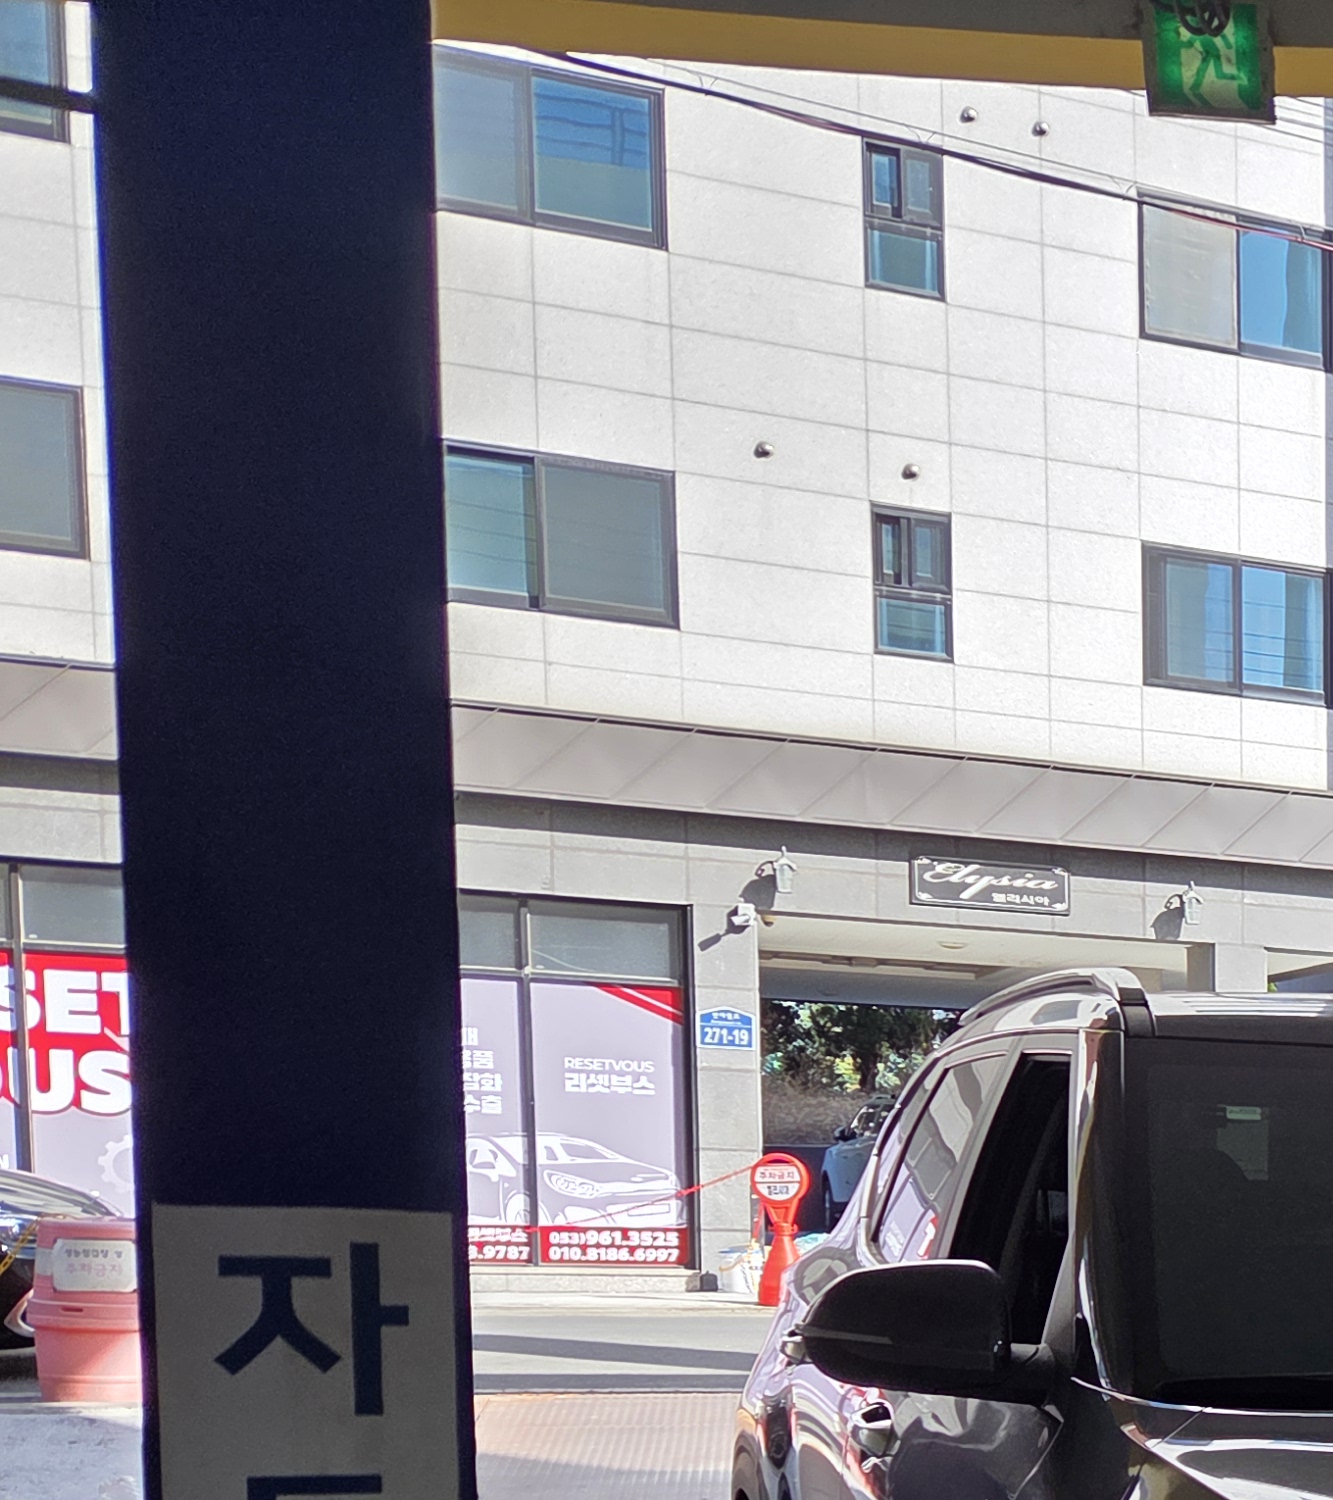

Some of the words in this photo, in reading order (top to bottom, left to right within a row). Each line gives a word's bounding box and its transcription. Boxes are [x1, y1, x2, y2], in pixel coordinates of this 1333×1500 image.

[923, 863, 1058, 899] Elysia
[704, 1027, 748, 1045] 271-19
[564, 1057, 655, 1073] RESETVOUS
[0, 1046, 132, 1115] US
[565, 1073, 655, 1095] 리셋부스
